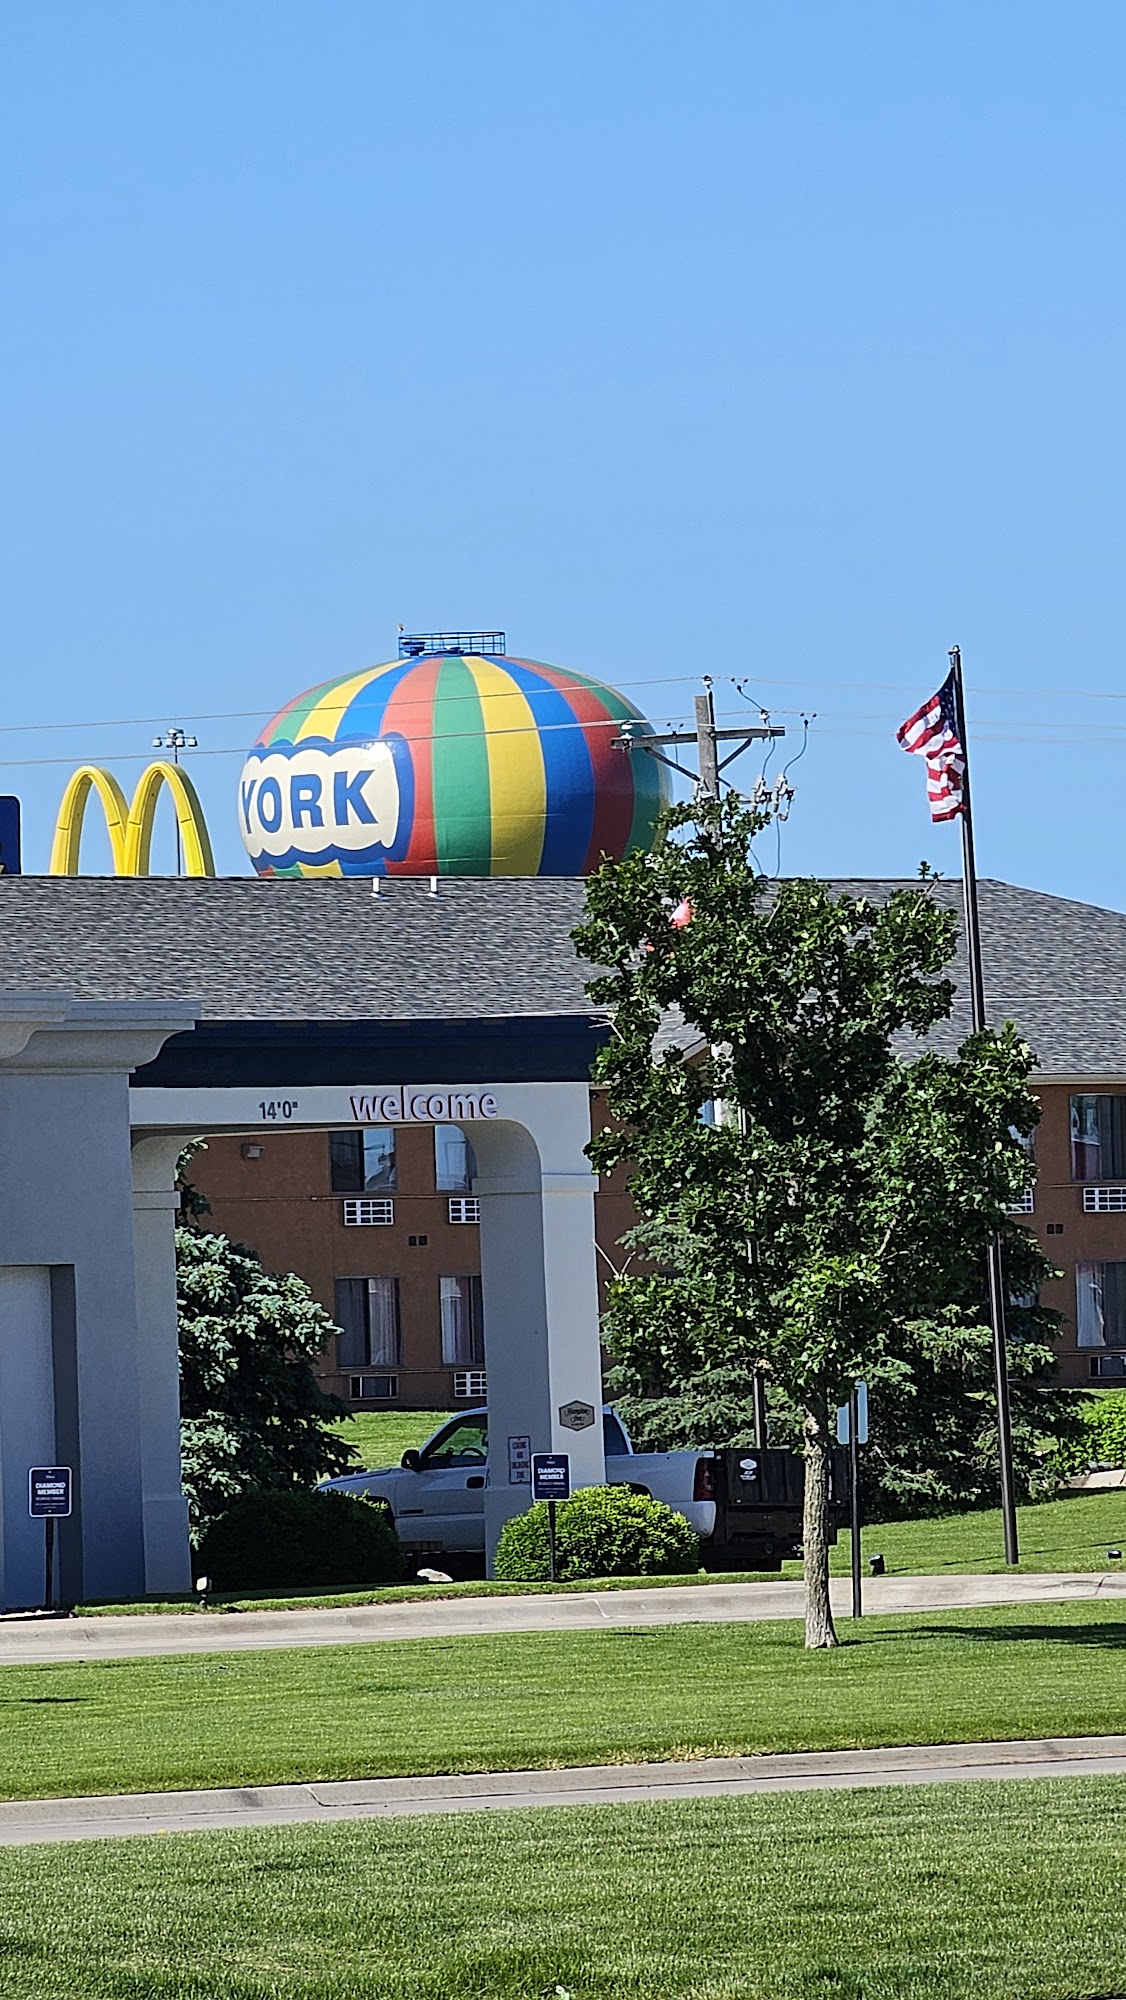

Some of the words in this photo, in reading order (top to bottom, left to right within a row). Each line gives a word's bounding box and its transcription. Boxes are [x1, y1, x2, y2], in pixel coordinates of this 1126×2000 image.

[242, 769, 379, 834] YORK
[258, 1101, 299, 1119] 14'0"
[350, 1085, 498, 1120] welcome
